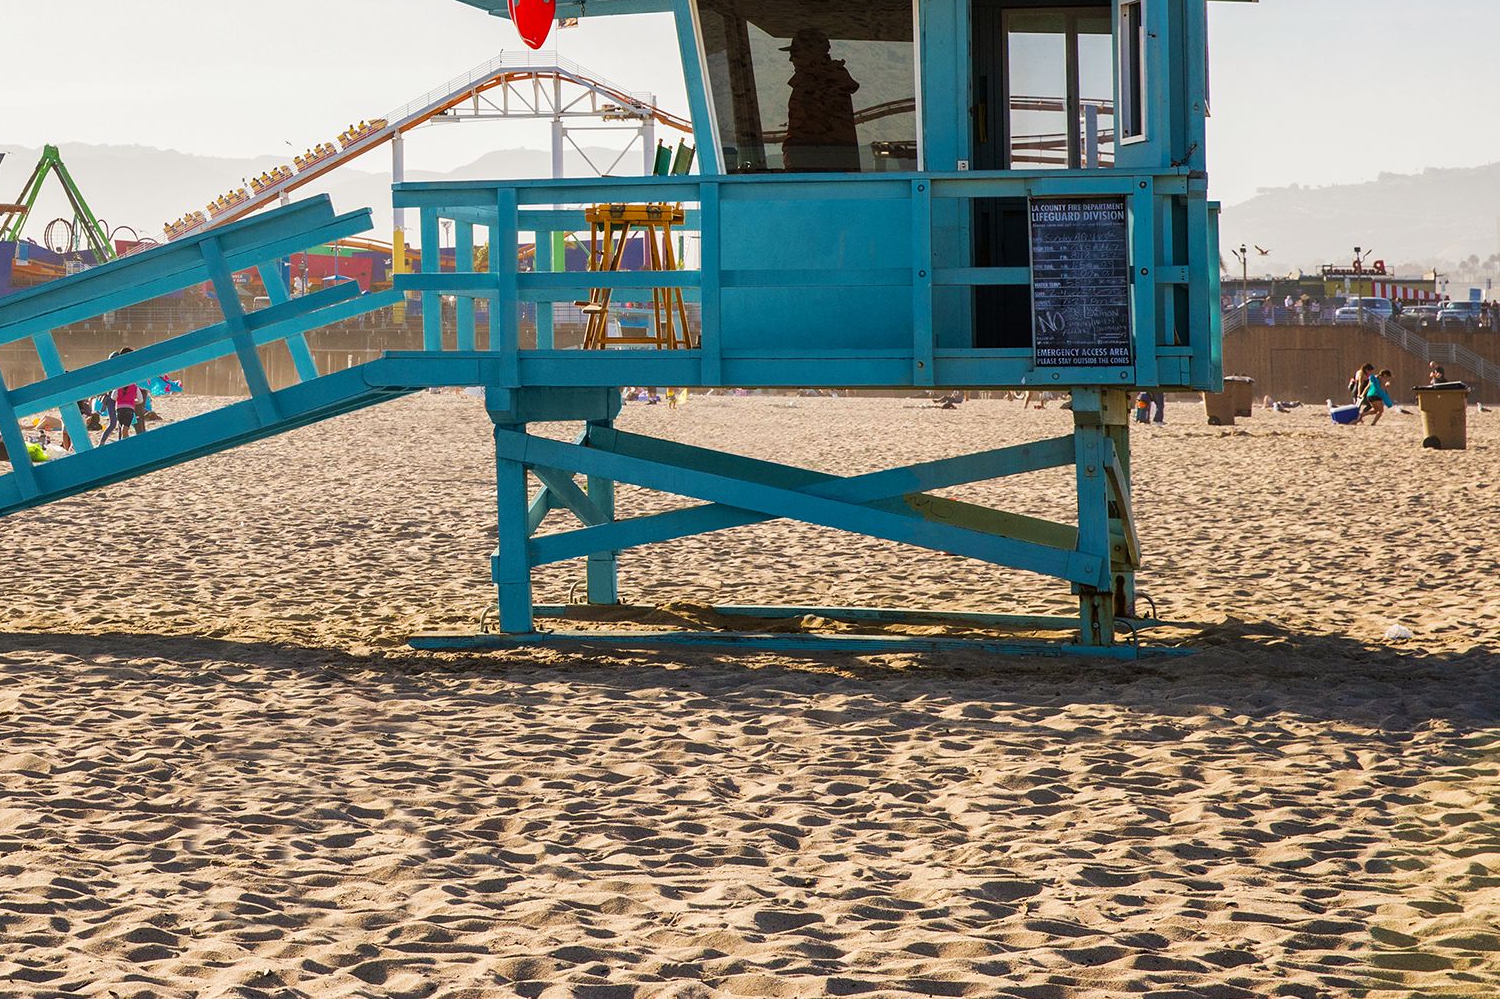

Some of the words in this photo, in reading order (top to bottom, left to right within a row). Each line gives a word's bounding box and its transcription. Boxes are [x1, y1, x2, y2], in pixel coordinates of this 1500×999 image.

[1040, 204, 1066, 212] COUNTY
[1031, 212, 1081, 222] LIFEGUARD
[1083, 211, 1125, 221] DIVISION
[1037, 311, 1066, 333] NO
[1037, 348, 1080, 357] EMERGENCY
[1081, 348, 1108, 356] ACCESS
[1109, 347, 1129, 356] AREA
[1037, 357, 1057, 365] PLEASE
[1058, 357, 1072, 365] STAY
